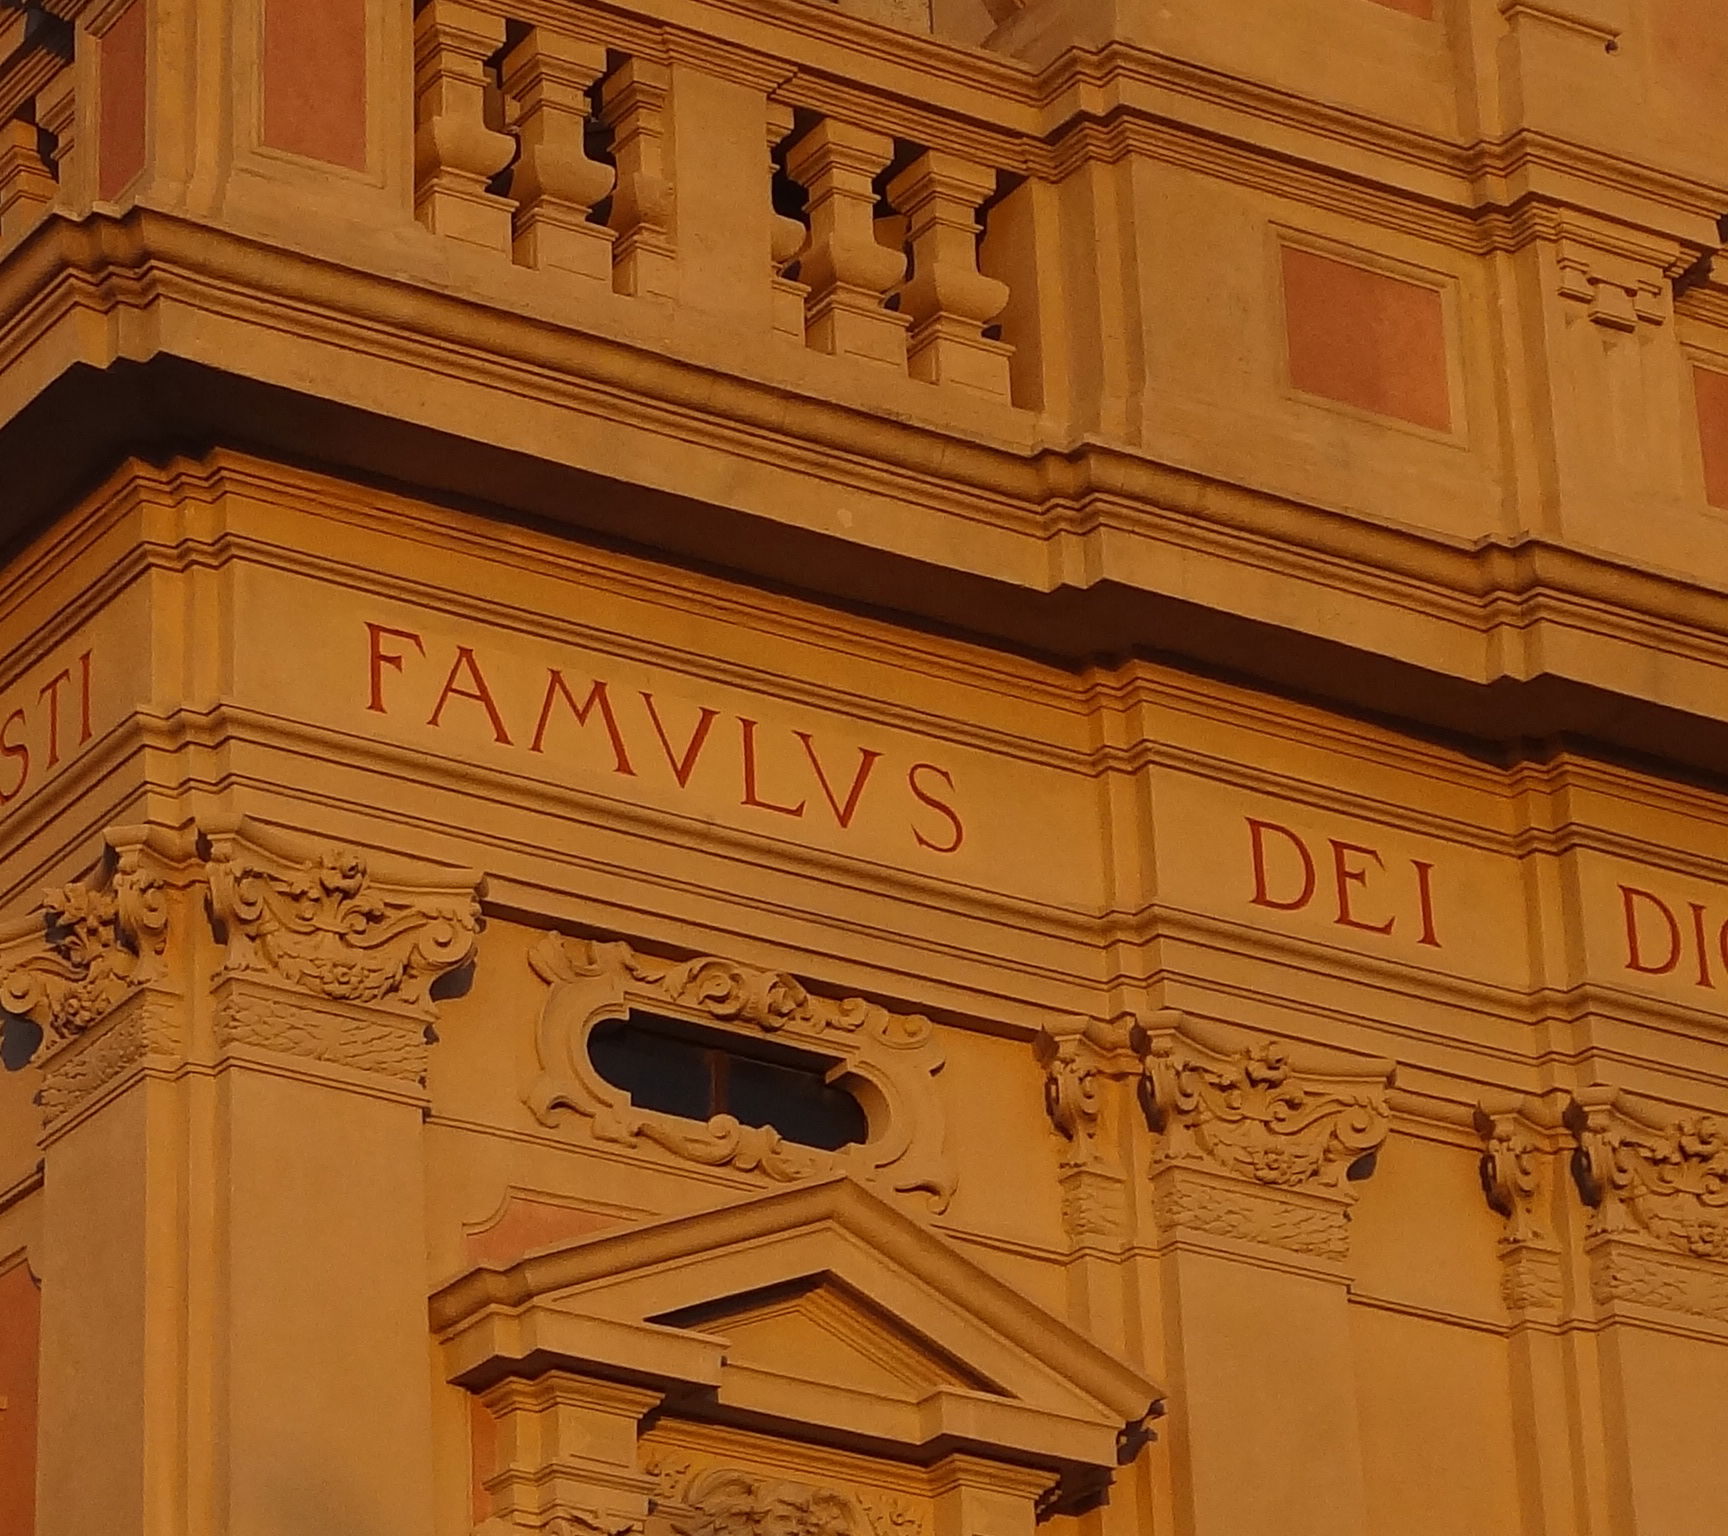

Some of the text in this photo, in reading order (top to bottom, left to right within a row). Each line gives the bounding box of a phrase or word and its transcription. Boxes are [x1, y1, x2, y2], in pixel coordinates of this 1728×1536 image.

[363, 621, 1728, 990] FAMVLVS DEI DI
